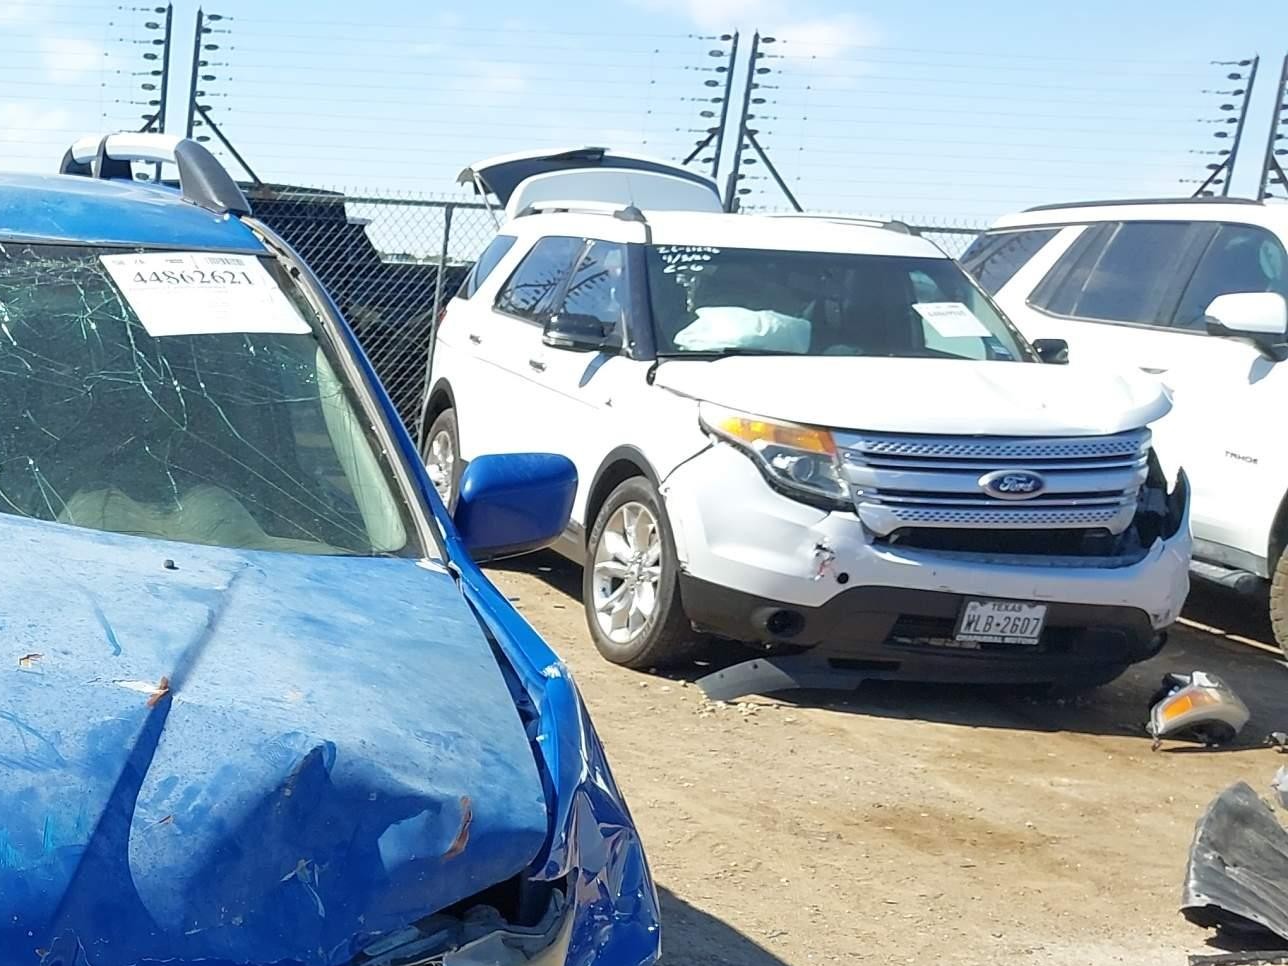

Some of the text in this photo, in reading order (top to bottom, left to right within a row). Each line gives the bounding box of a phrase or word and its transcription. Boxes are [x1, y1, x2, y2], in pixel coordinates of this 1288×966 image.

[132, 270, 255, 285] 44862621
[999, 475, 1035, 492] Ford
[992, 603, 1023, 612] TEXAS
